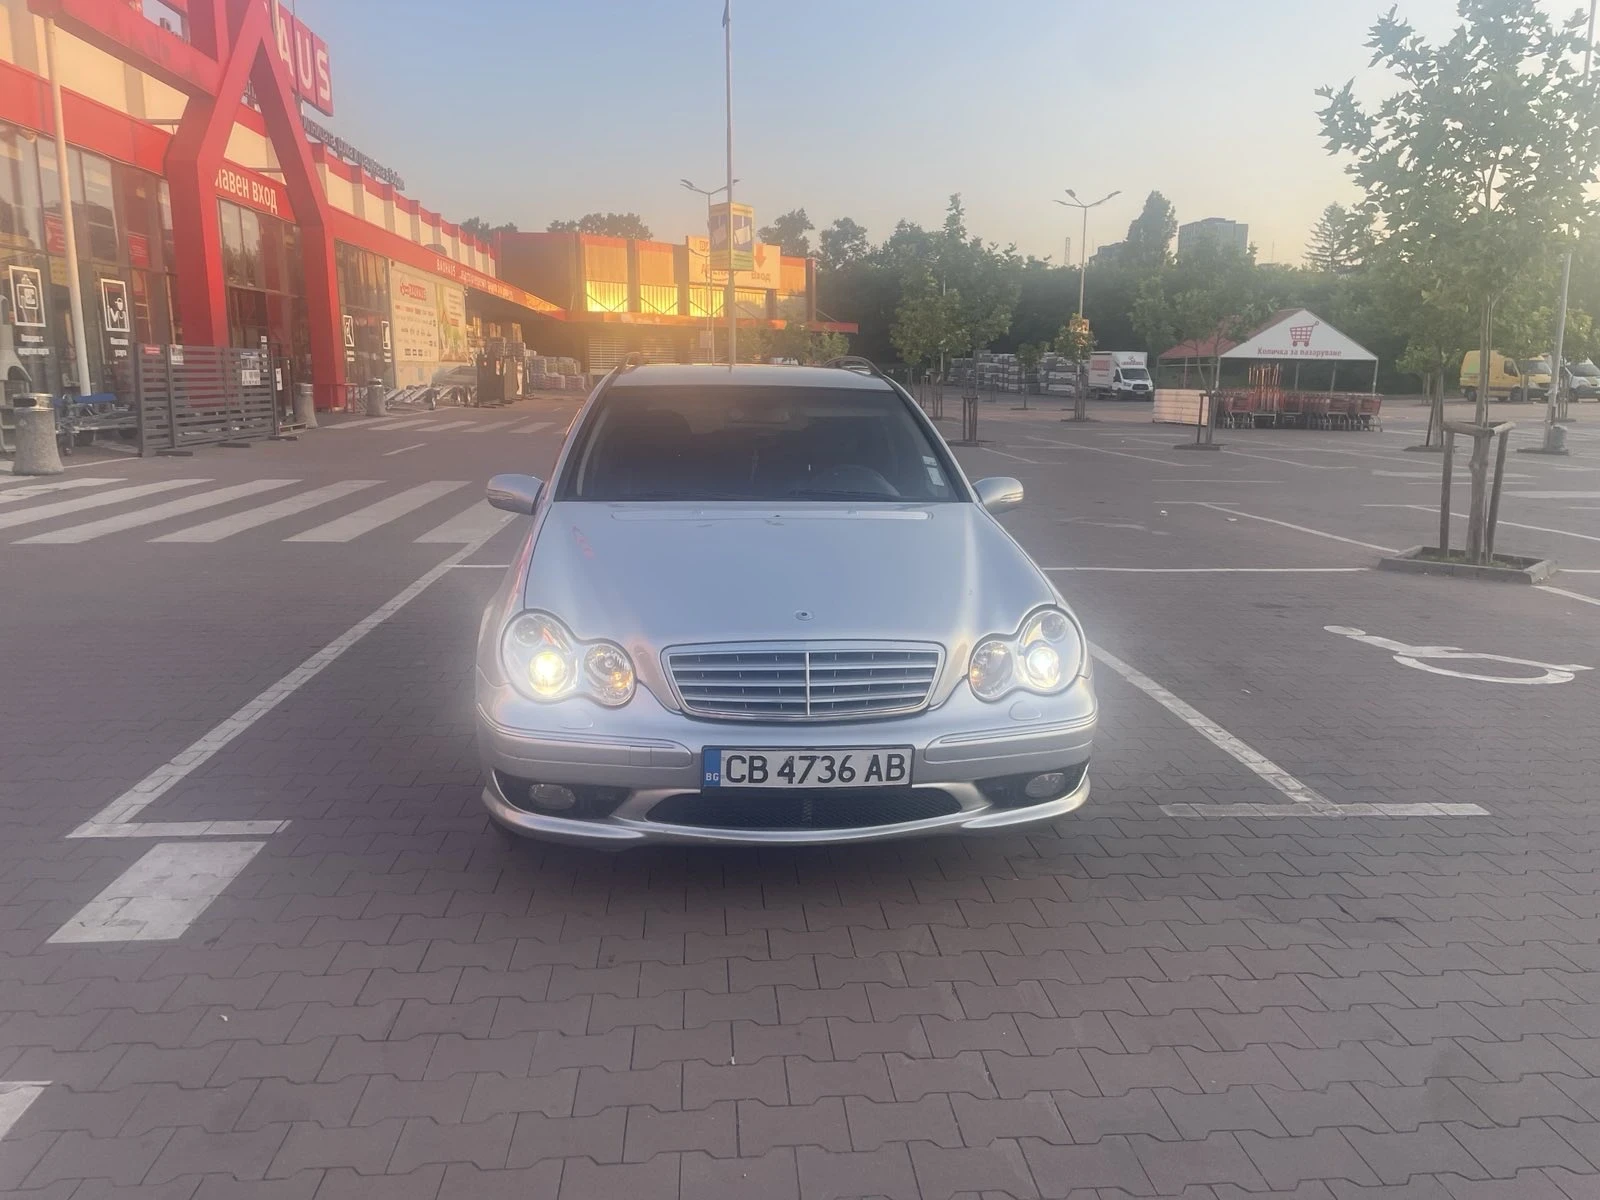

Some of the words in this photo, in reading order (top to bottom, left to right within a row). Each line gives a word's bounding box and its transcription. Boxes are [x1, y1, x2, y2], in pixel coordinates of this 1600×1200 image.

[215, 169, 249, 199] лавен
[252, 181, 278, 215] вход
[705, 772, 719, 782] BG
[726, 754, 769, 784] CB
[777, 754, 856, 785] 4736
[864, 753, 906, 783] AB
